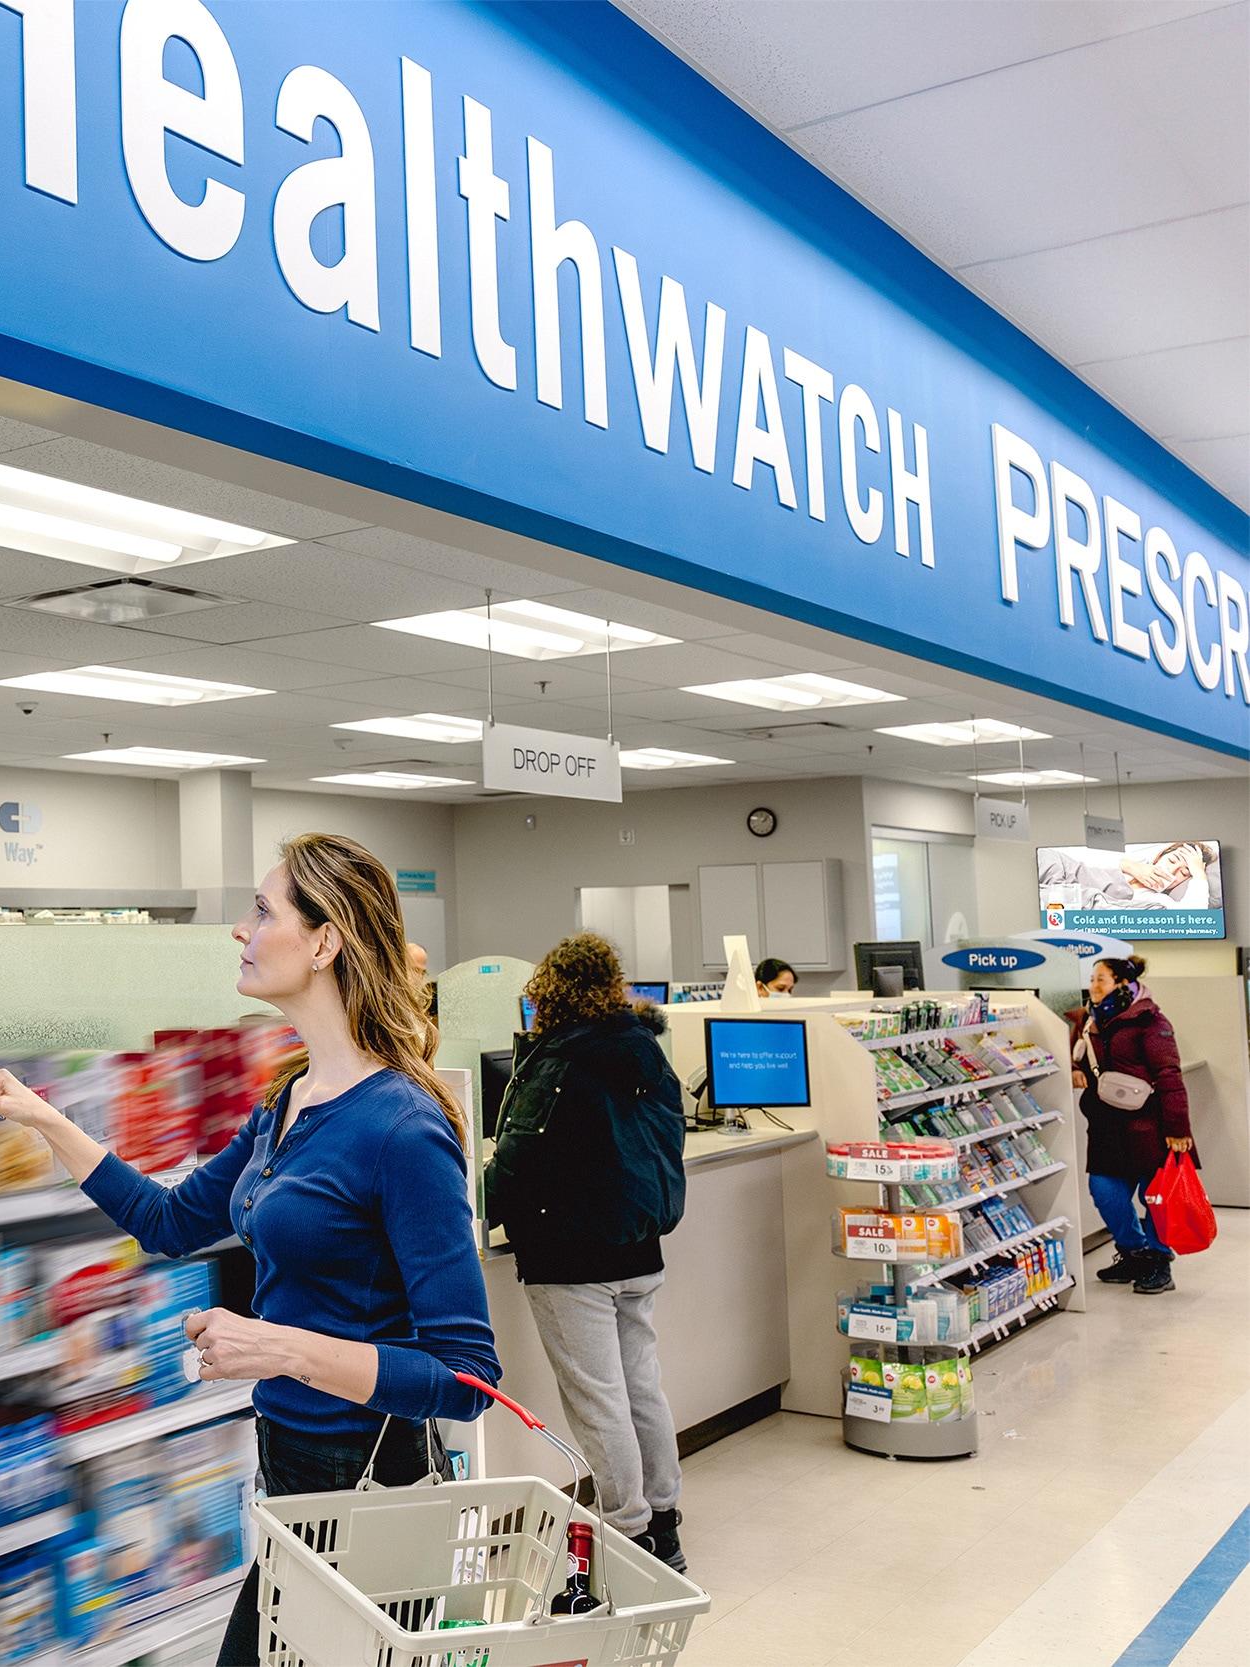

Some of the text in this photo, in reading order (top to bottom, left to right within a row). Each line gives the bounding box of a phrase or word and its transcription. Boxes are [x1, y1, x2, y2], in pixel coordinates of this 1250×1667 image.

[991, 422, 1250, 705] PRESCR
[513, 747, 597, 779] DROP OFF
[989, 811, 1017, 829] PICK UP
[1072, 915, 1217, 926] Cold and flu season is here.
[968, 953, 1018, 969] Pick up
[862, 1149, 888, 1158] SALE
[859, 1226, 884, 1236] SALE
